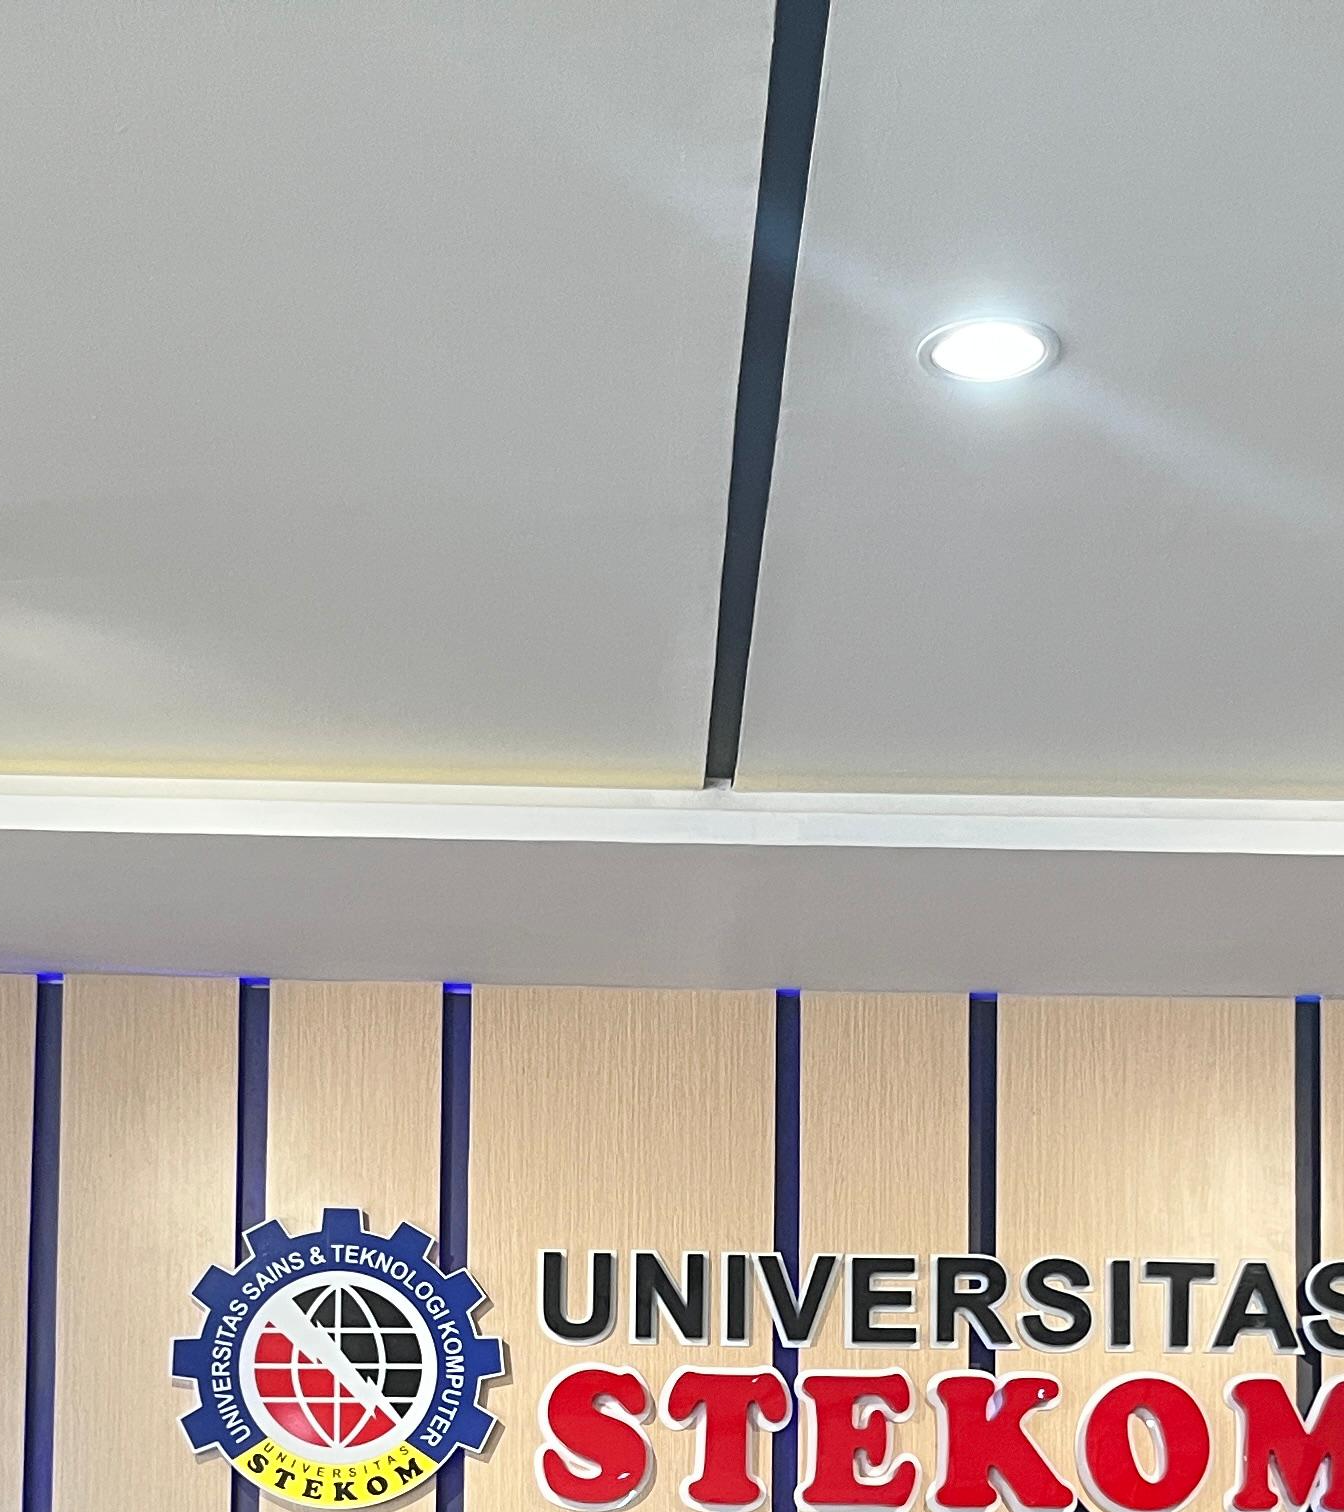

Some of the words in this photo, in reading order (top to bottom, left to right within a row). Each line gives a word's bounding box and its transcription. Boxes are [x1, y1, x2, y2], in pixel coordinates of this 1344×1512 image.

[211, 1300, 251, 1443] UNIVERSITAS
[242, 1250, 305, 1301] SAINS
[309, 1246, 326, 1265] &
[331, 1244, 451, 1322] TEKNOLOGI
[419, 1320, 465, 1448] KOMPUTER
[247, 1453, 424, 1501] STEKOM
[263, 1442, 410, 1478] UNIVERSITAS
